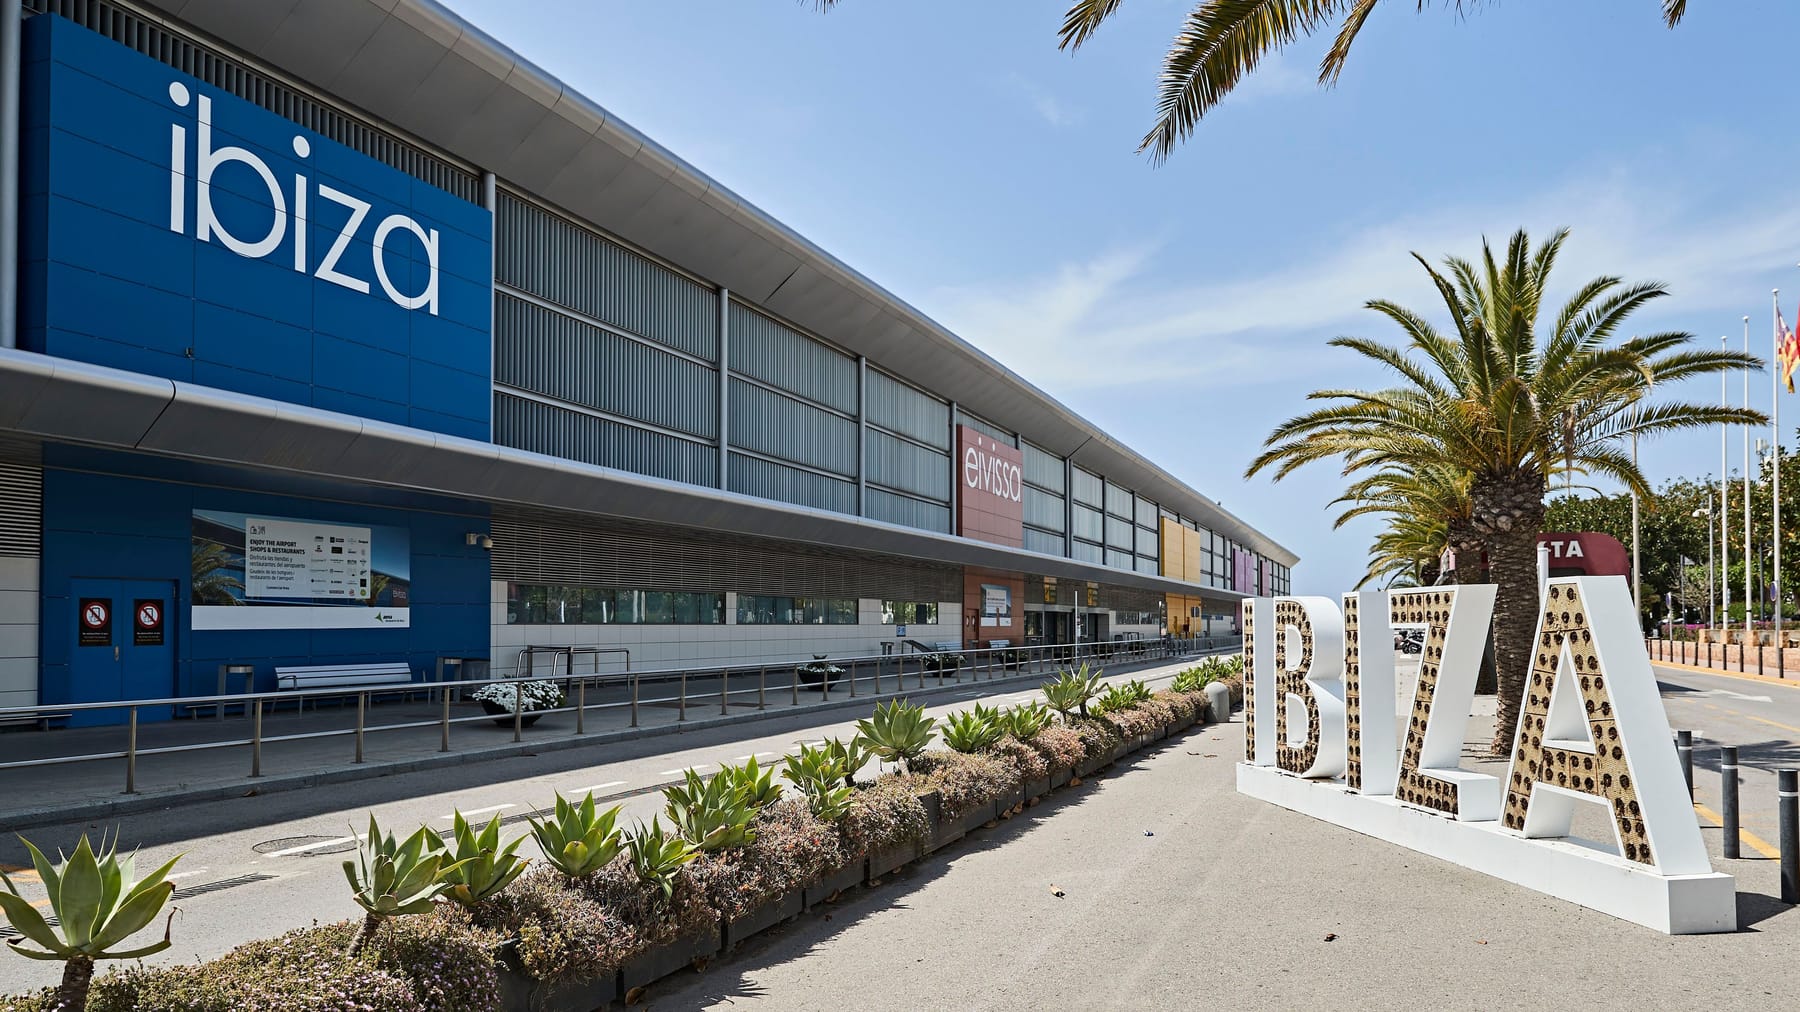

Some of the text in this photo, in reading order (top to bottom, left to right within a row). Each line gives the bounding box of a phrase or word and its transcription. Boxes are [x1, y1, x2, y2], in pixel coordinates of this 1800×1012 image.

[169, 81, 439, 316] ibiza
[965, 436, 1021, 502] eivissa
[1242, 576, 1712, 875] IBIZA
